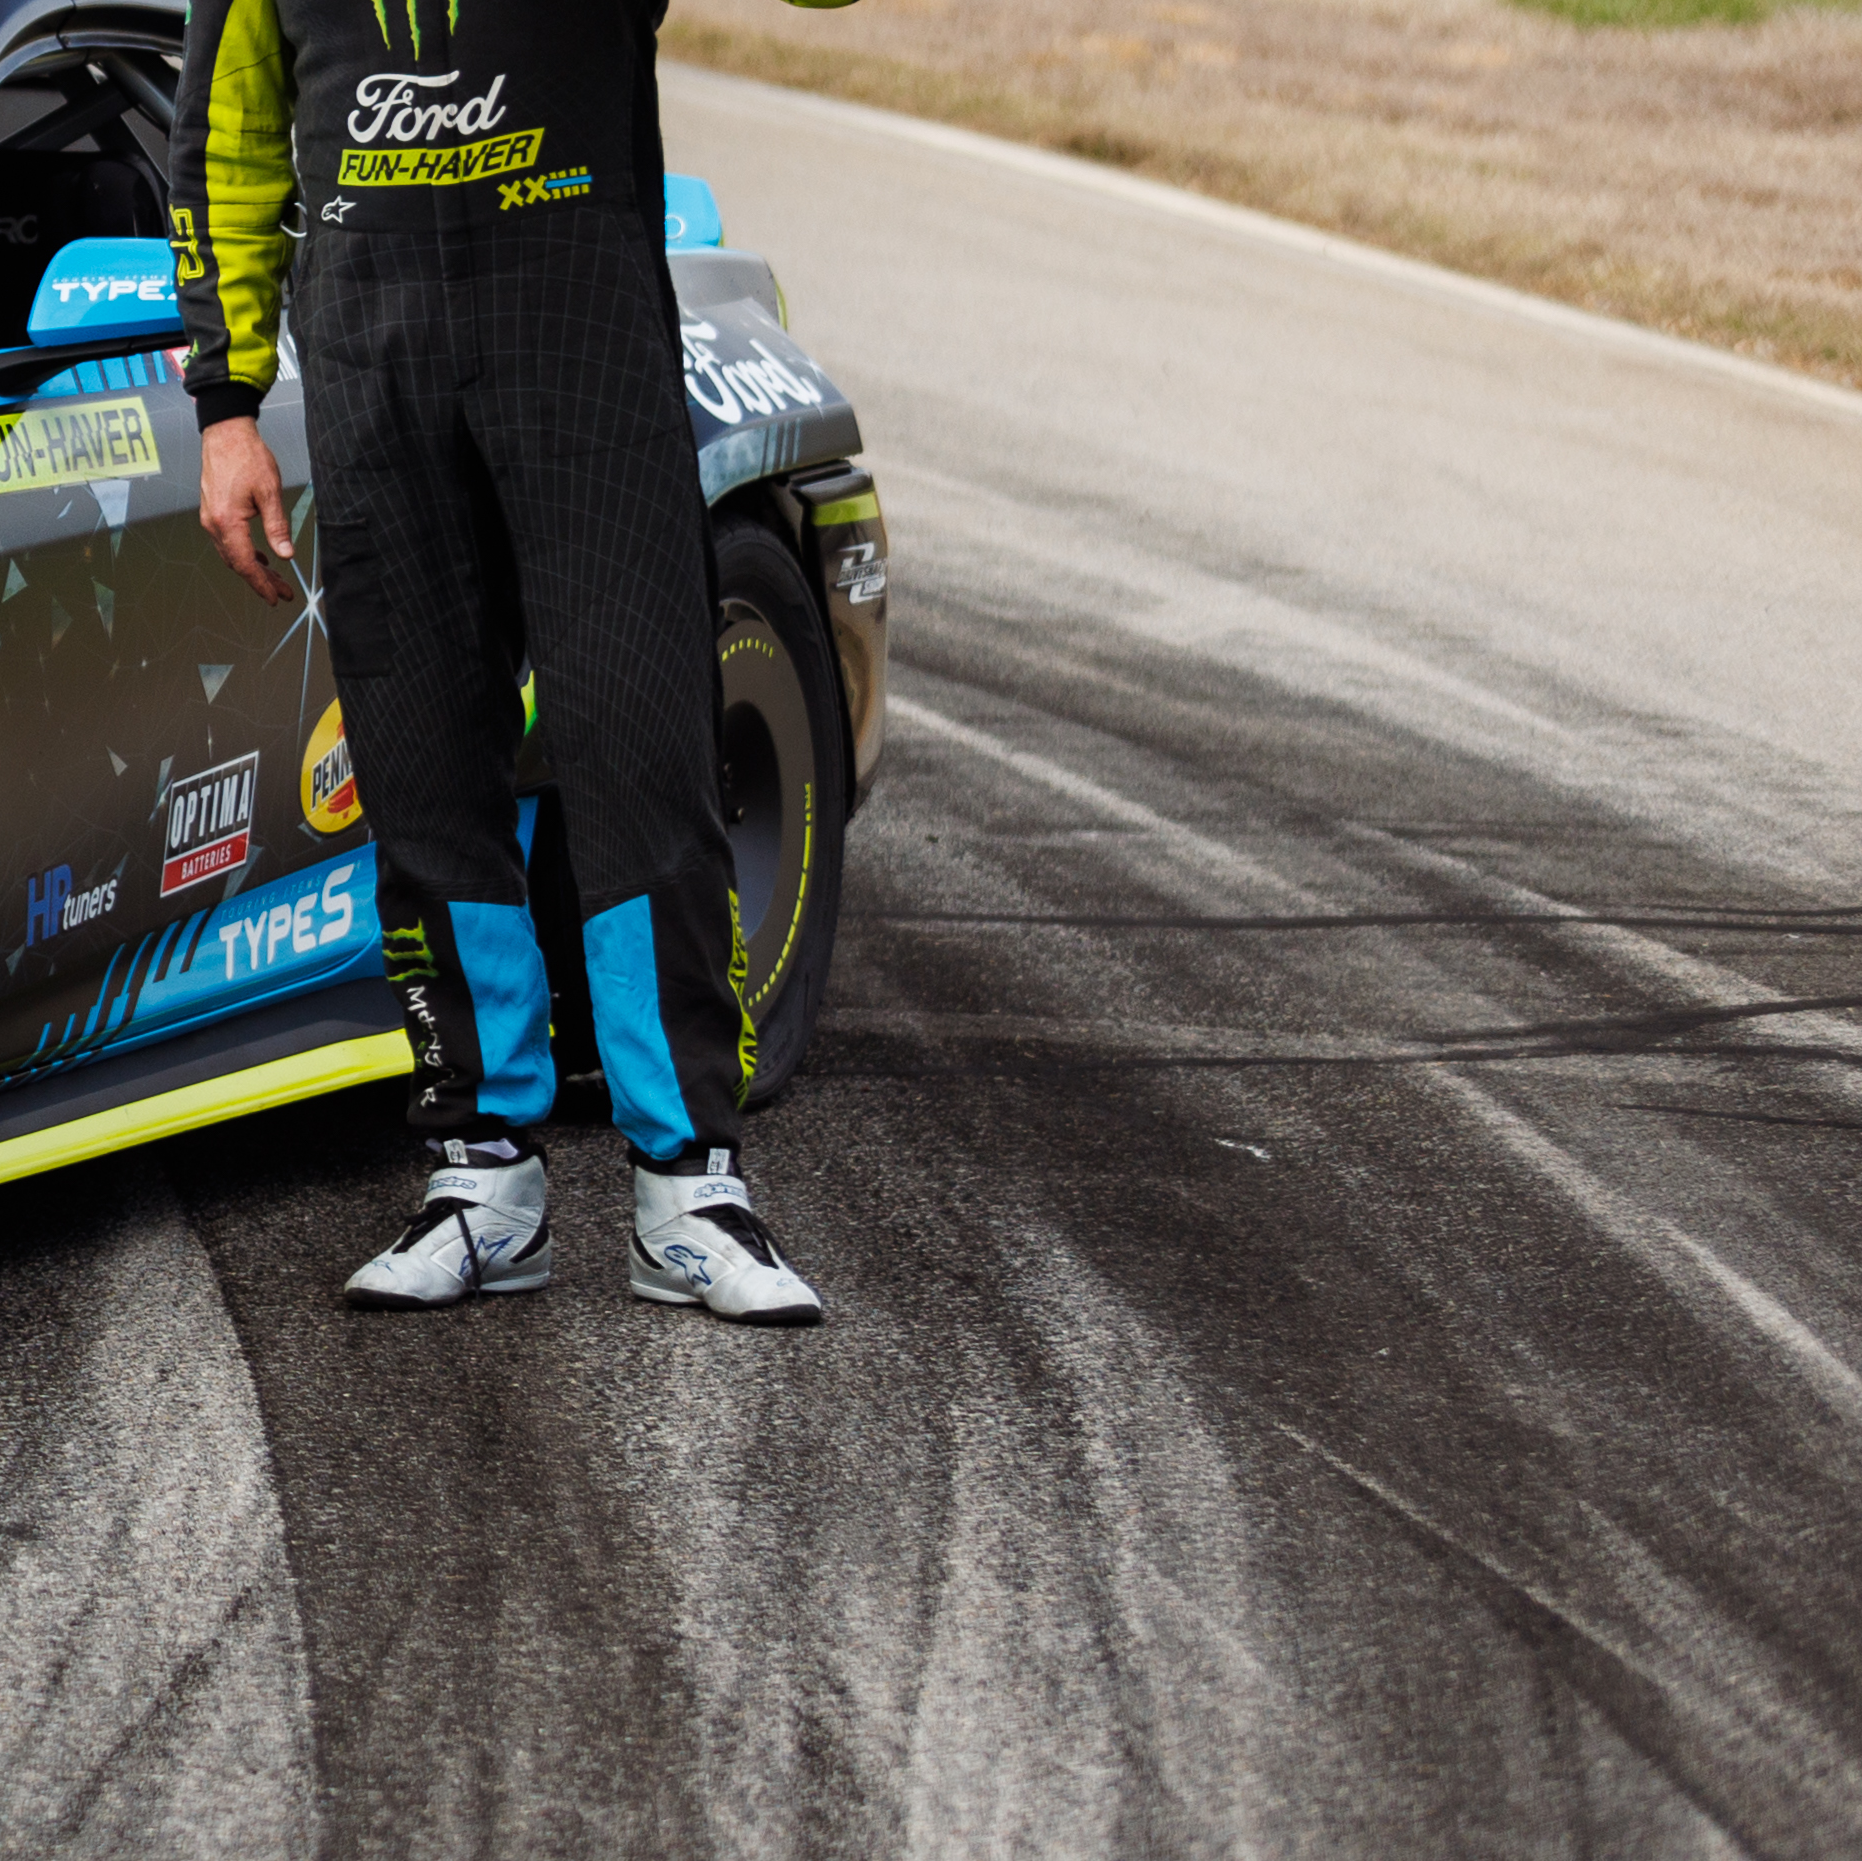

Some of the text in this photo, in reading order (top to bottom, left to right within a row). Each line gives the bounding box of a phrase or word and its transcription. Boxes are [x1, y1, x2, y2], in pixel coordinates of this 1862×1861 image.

[347, 70, 507, 143] Ford
[342, 134, 535, 181] FUN-HAVER
[52, 280, 178, 303] TYPE
[680, 320, 822, 425] Ford
[169, 768, 253, 850] OPTIMA
[311, 736, 355, 812] PENN
[180, 843, 233, 881] BATTERIES
